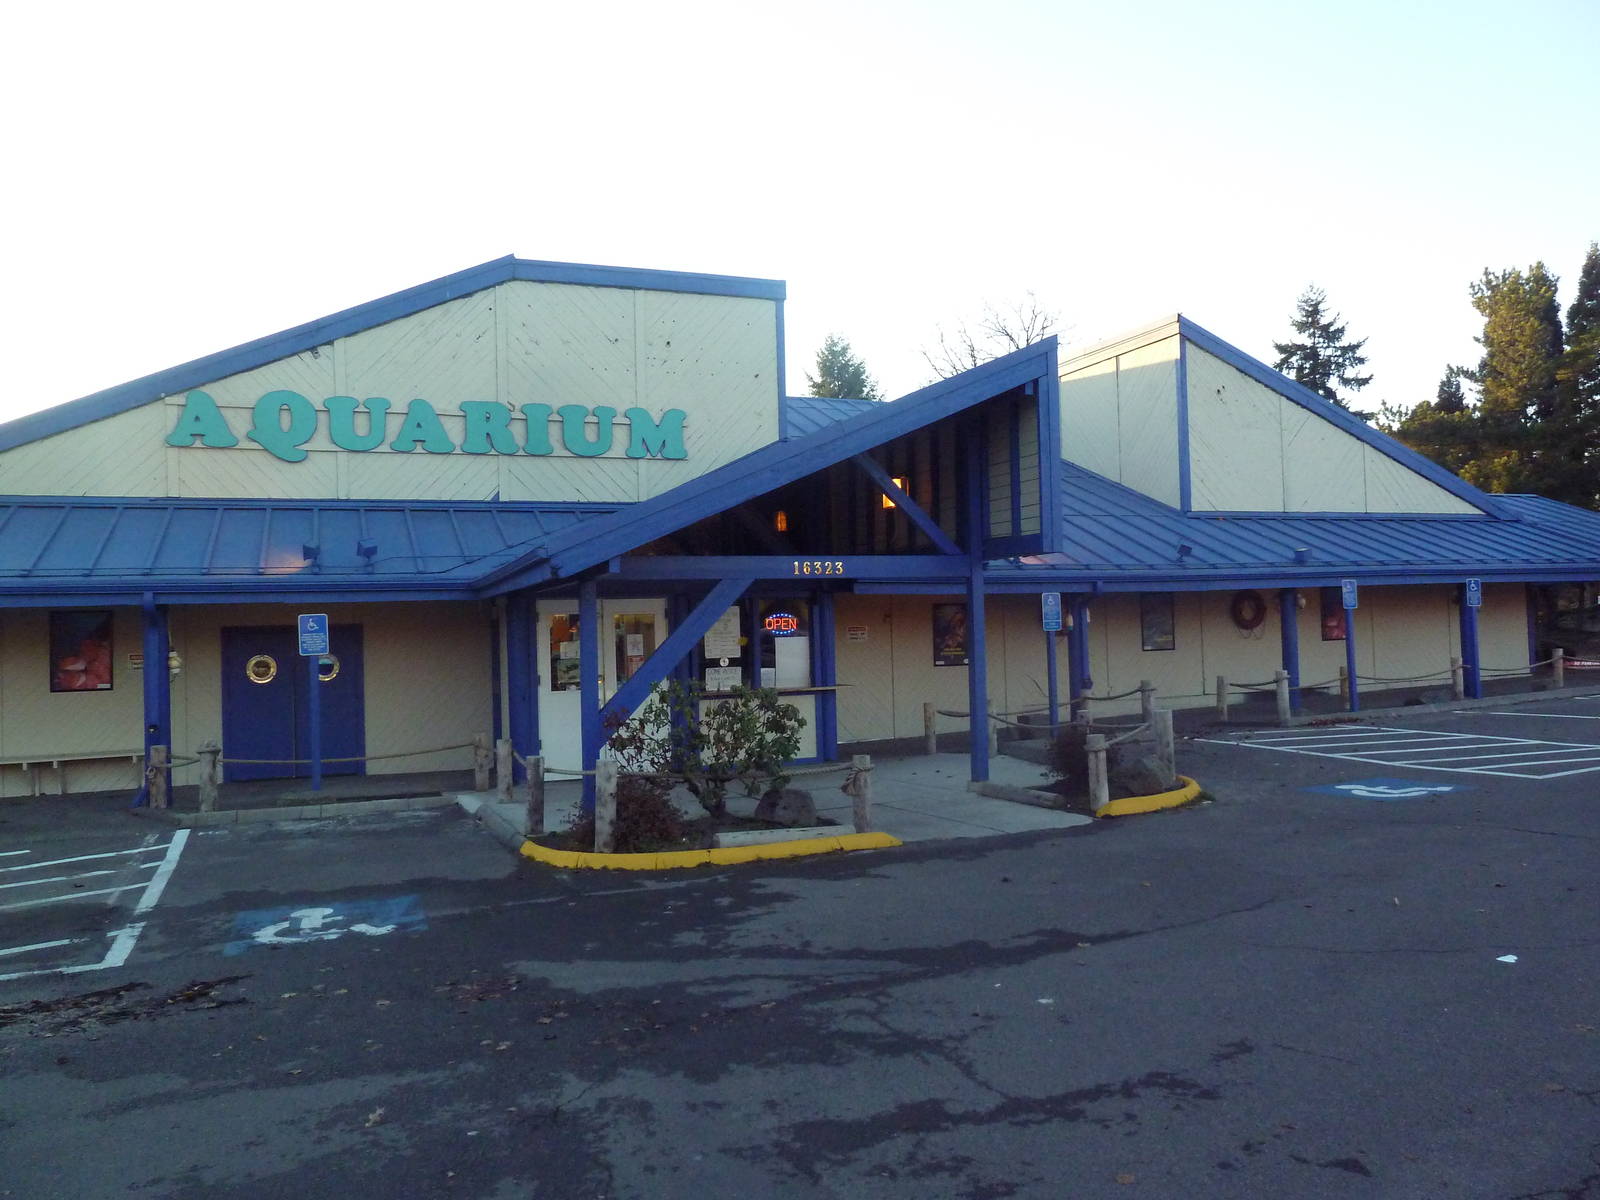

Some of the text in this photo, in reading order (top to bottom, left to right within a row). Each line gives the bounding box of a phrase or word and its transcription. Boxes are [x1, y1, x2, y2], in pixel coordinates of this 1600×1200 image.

[165, 389, 688, 463] AQUARIUM
[793, 561, 844, 575] 16323
[765, 618, 797, 630] OPEN
